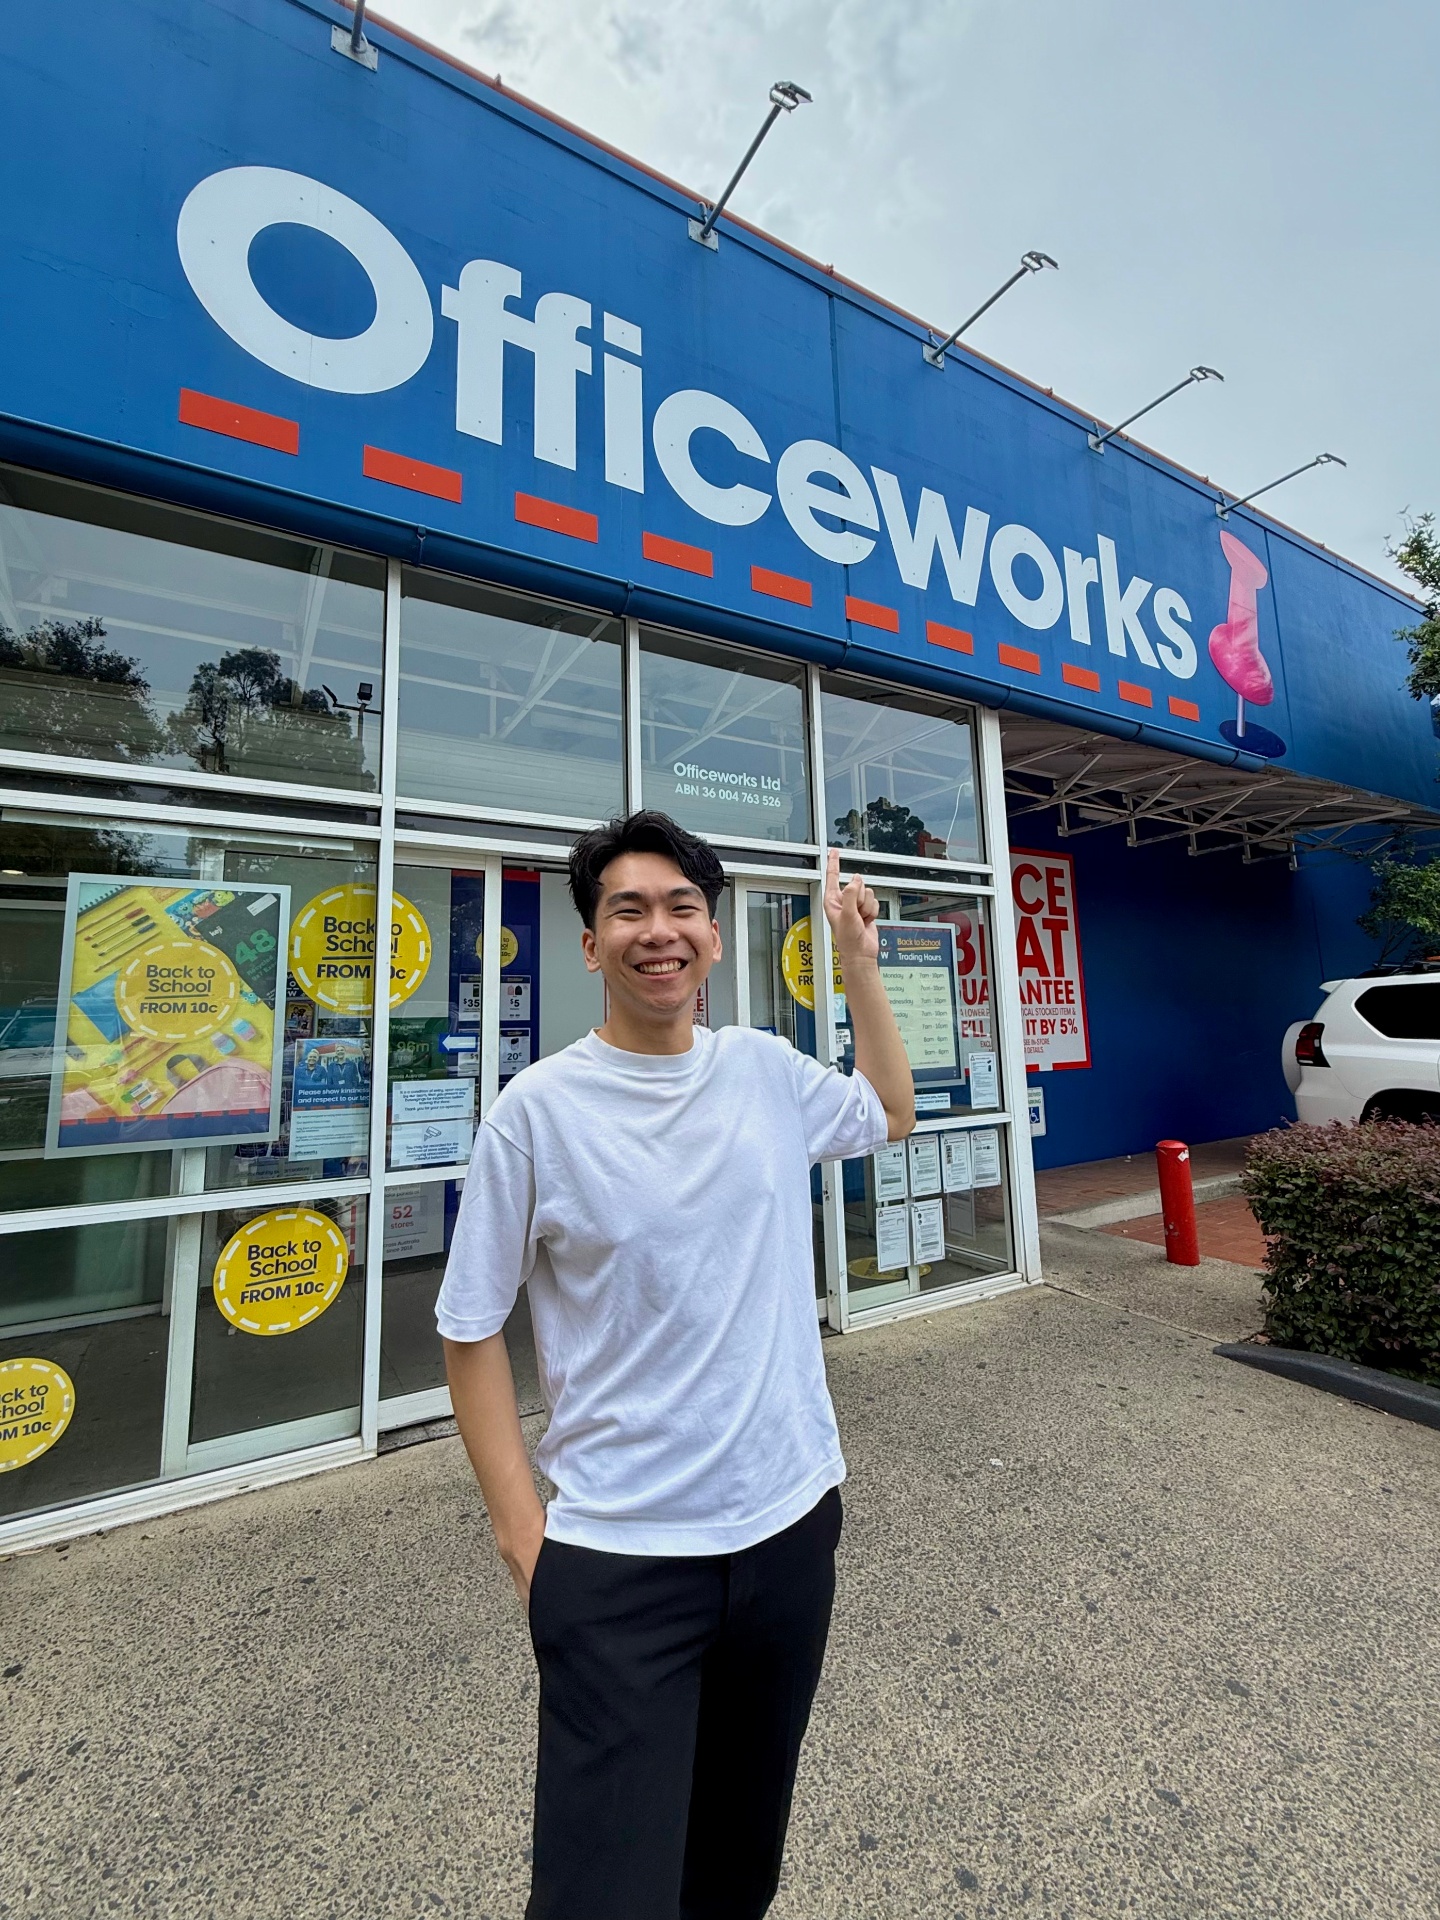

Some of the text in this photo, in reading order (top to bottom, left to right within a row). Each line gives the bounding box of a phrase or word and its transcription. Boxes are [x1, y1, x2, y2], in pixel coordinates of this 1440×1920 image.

[177, 165, 1198, 679] Officeworks
[673, 762, 781, 791] Officeworks Ltd
[675, 783, 781, 807] ABN 36 004 763 526
[323, 916, 375, 934] Back
[235, 928, 276, 965] 48
[898, 953, 923, 962] Trading
[146, 964, 216, 978] Back to
[317, 964, 371, 978] FROM
[147, 979, 211, 994] School
[139, 1001, 218, 1014] FROM 10c
[463, 998, 480, 1008] $35
[510, 998, 520, 1008] $5
[889, 998, 913, 1006] ednesday
[1035, 1008, 1059, 1016] STOCKED
[1026, 1019, 1037, 1035] IT
[1040, 1019, 1056, 1035] BY
[1060, 1018, 1078, 1035] 5%
[393, 1205, 413, 1220] 52
[390, 1221, 415, 1230] stores
[248, 1239, 322, 1260] Back to
[249, 1253, 318, 1277] School
[240, 1281, 325, 1304] FROM 10c
[0, 1384, 49, 1404] ck to
[22, 1421, 52, 1436] 10c
